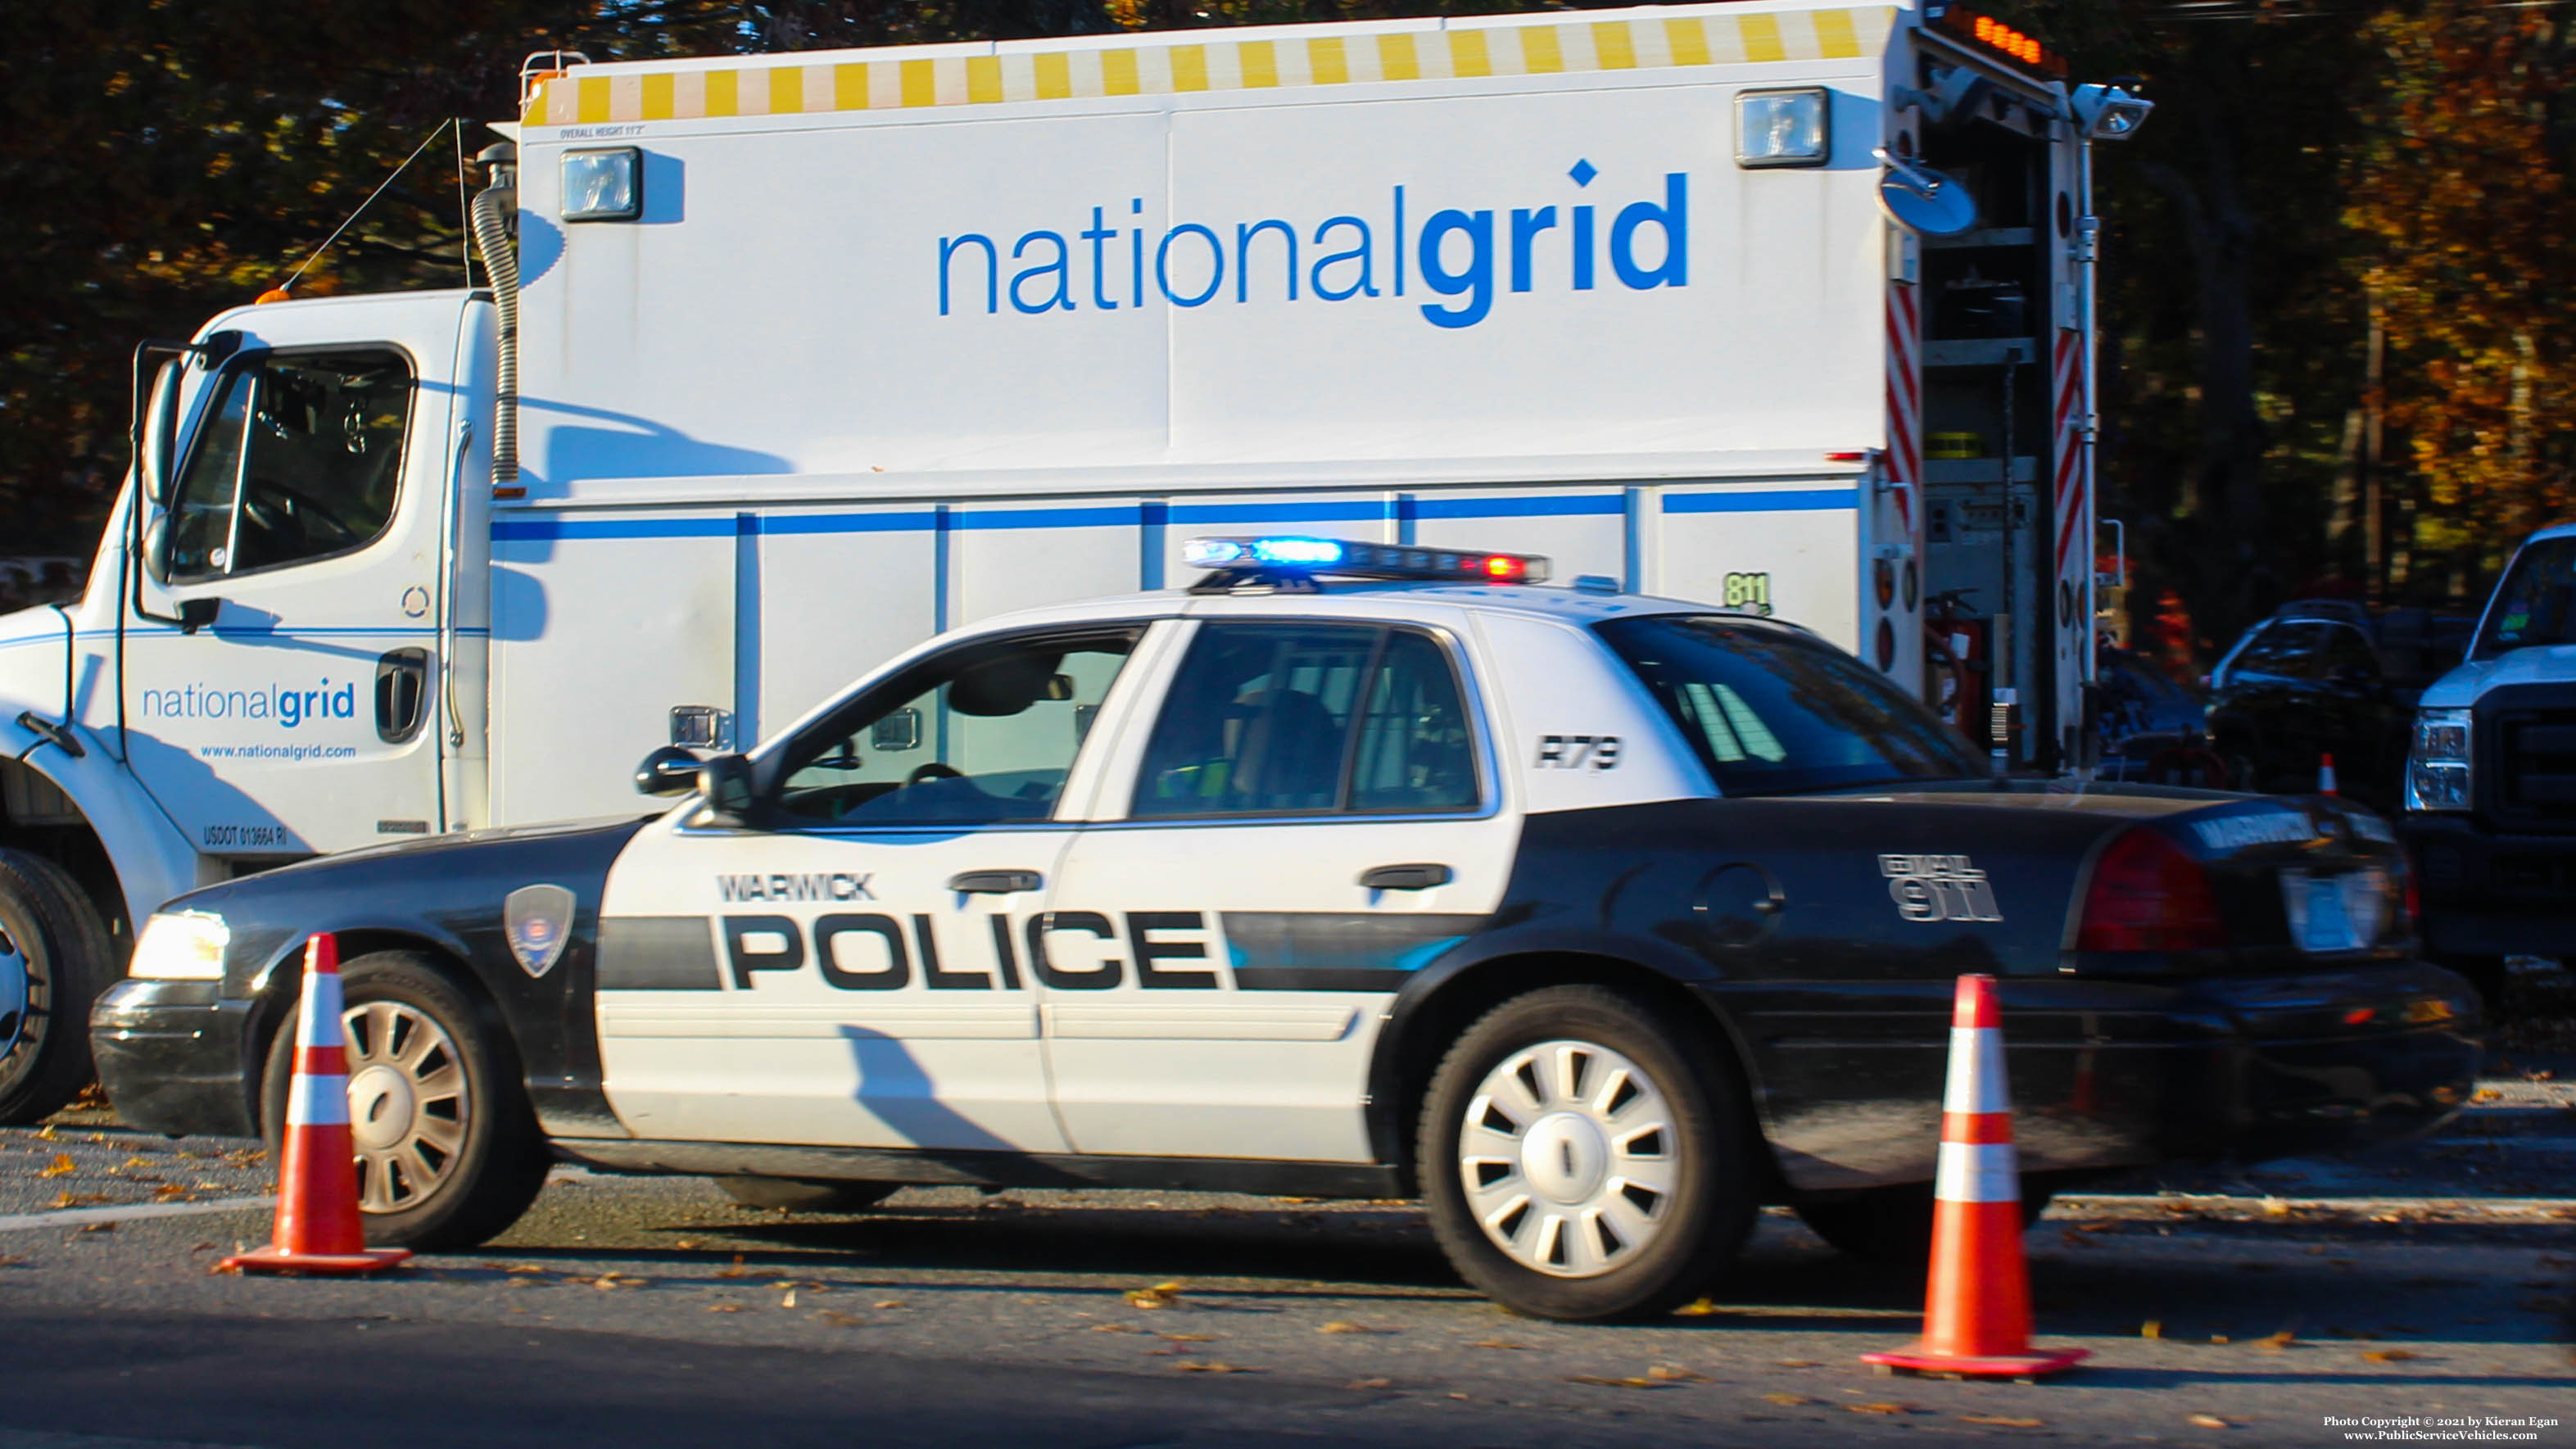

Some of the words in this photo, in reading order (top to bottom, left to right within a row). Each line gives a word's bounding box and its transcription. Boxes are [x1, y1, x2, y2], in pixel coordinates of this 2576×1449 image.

[560, 127, 595, 139] OVERALL
[596, 125, 623, 137] HEIGHT
[937, 157, 1690, 328] nationalgrid
[1723, 572, 1770, 607] 811
[143, 677, 355, 727] nationalgrid
[201, 744, 356, 761] www.nationalgrid.com
[1534, 735, 1621, 770] R79
[203, 826, 238, 846] USDOT
[717, 872, 877, 901] WARWICK
[1889, 876, 2004, 921] 911
[721, 910, 1225, 991] POLICE
